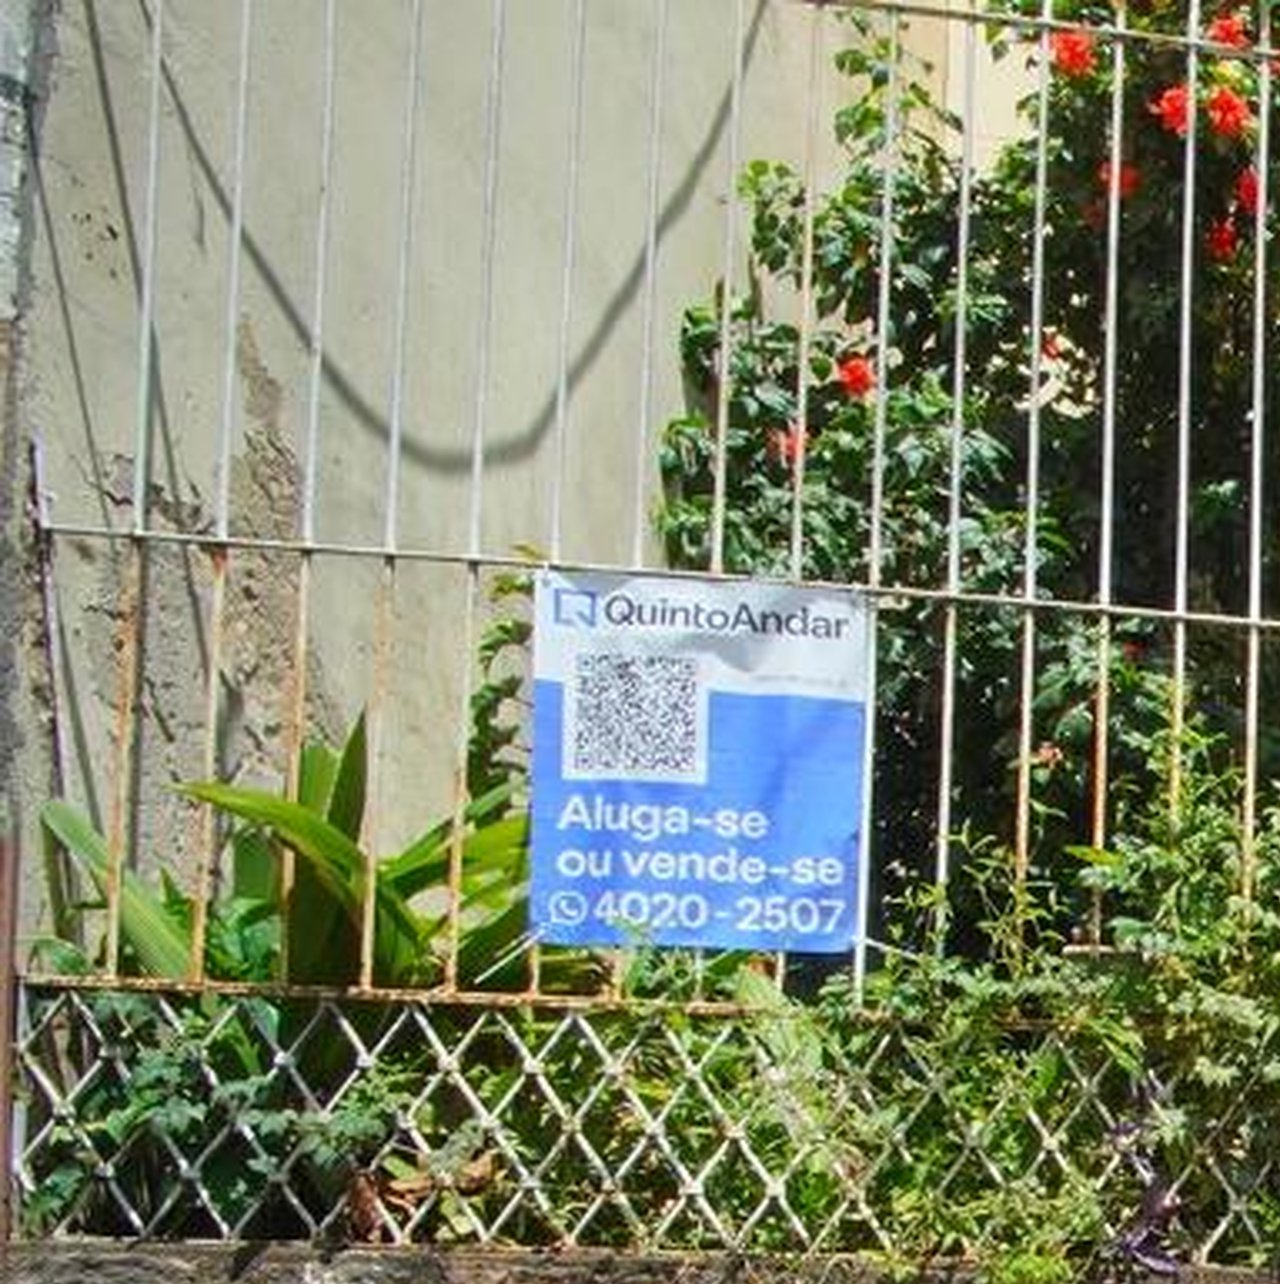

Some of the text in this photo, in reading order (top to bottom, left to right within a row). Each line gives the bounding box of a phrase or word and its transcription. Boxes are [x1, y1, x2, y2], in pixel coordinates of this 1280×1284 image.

[604, 594, 850, 639] QuintoAndar
[556, 795, 769, 841] Aluga-se
[556, 848, 844, 885] ou vende-se
